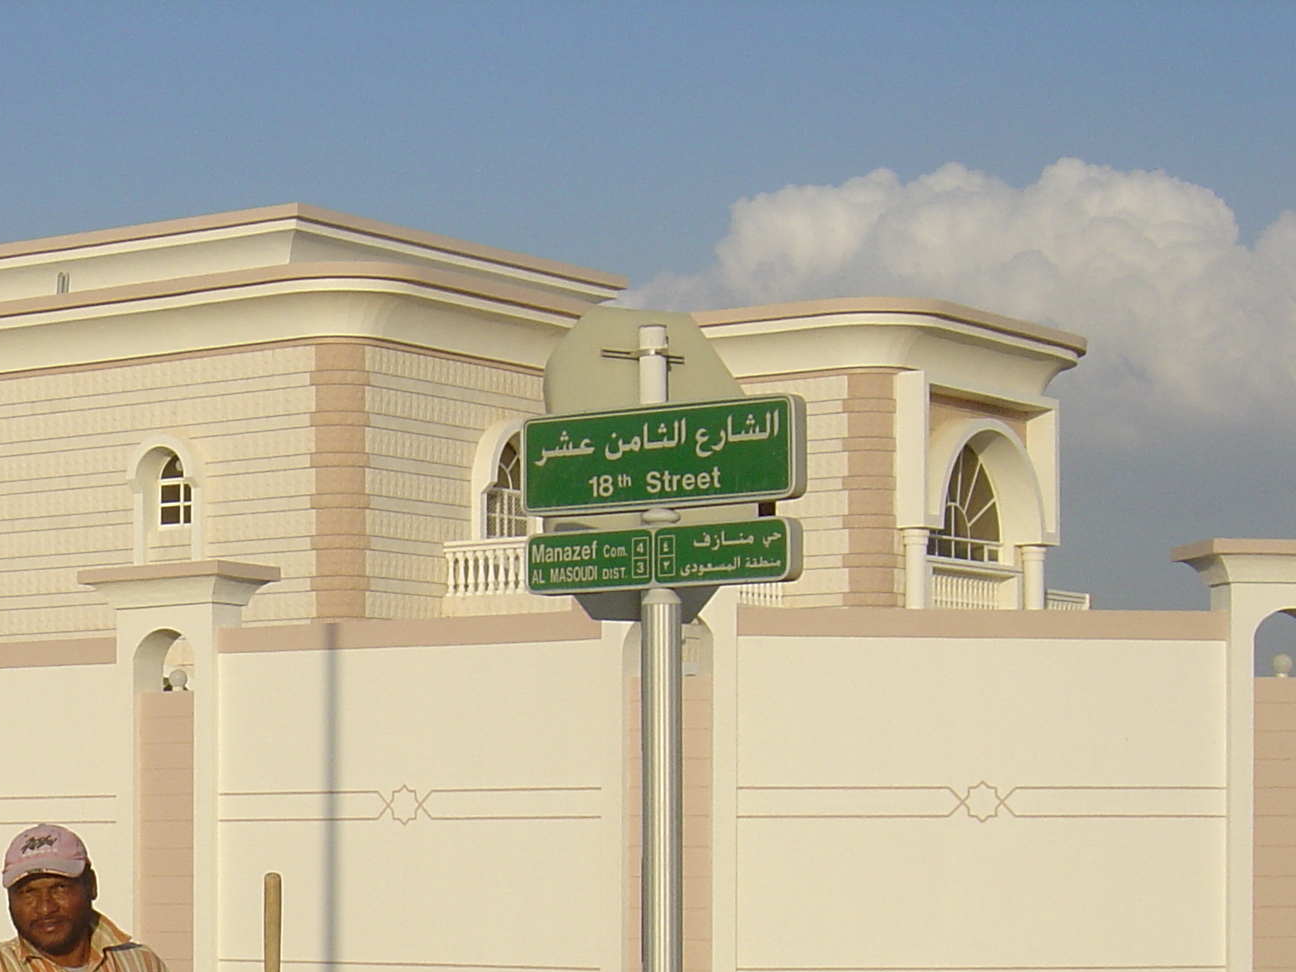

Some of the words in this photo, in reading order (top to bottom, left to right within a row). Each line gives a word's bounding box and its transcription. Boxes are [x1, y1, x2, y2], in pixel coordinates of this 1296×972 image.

[604, 417, 686, 460] الثامن
[695, 409, 780, 457] الشارع
[534, 430, 595, 466] عشر
[588, 473, 632, 498] 18th
[646, 466, 721, 493] Street
[532, 540, 598, 563] Manazef
[603, 544, 628, 558] Com.
[636, 542, 644, 553] 4
[636, 562, 644, 573] 3
[745, 556, 781, 568] منطقة
[532, 569, 545, 584] AL
[550, 565, 598, 583] MASOUDI
[602, 567, 627, 579] DIST.
